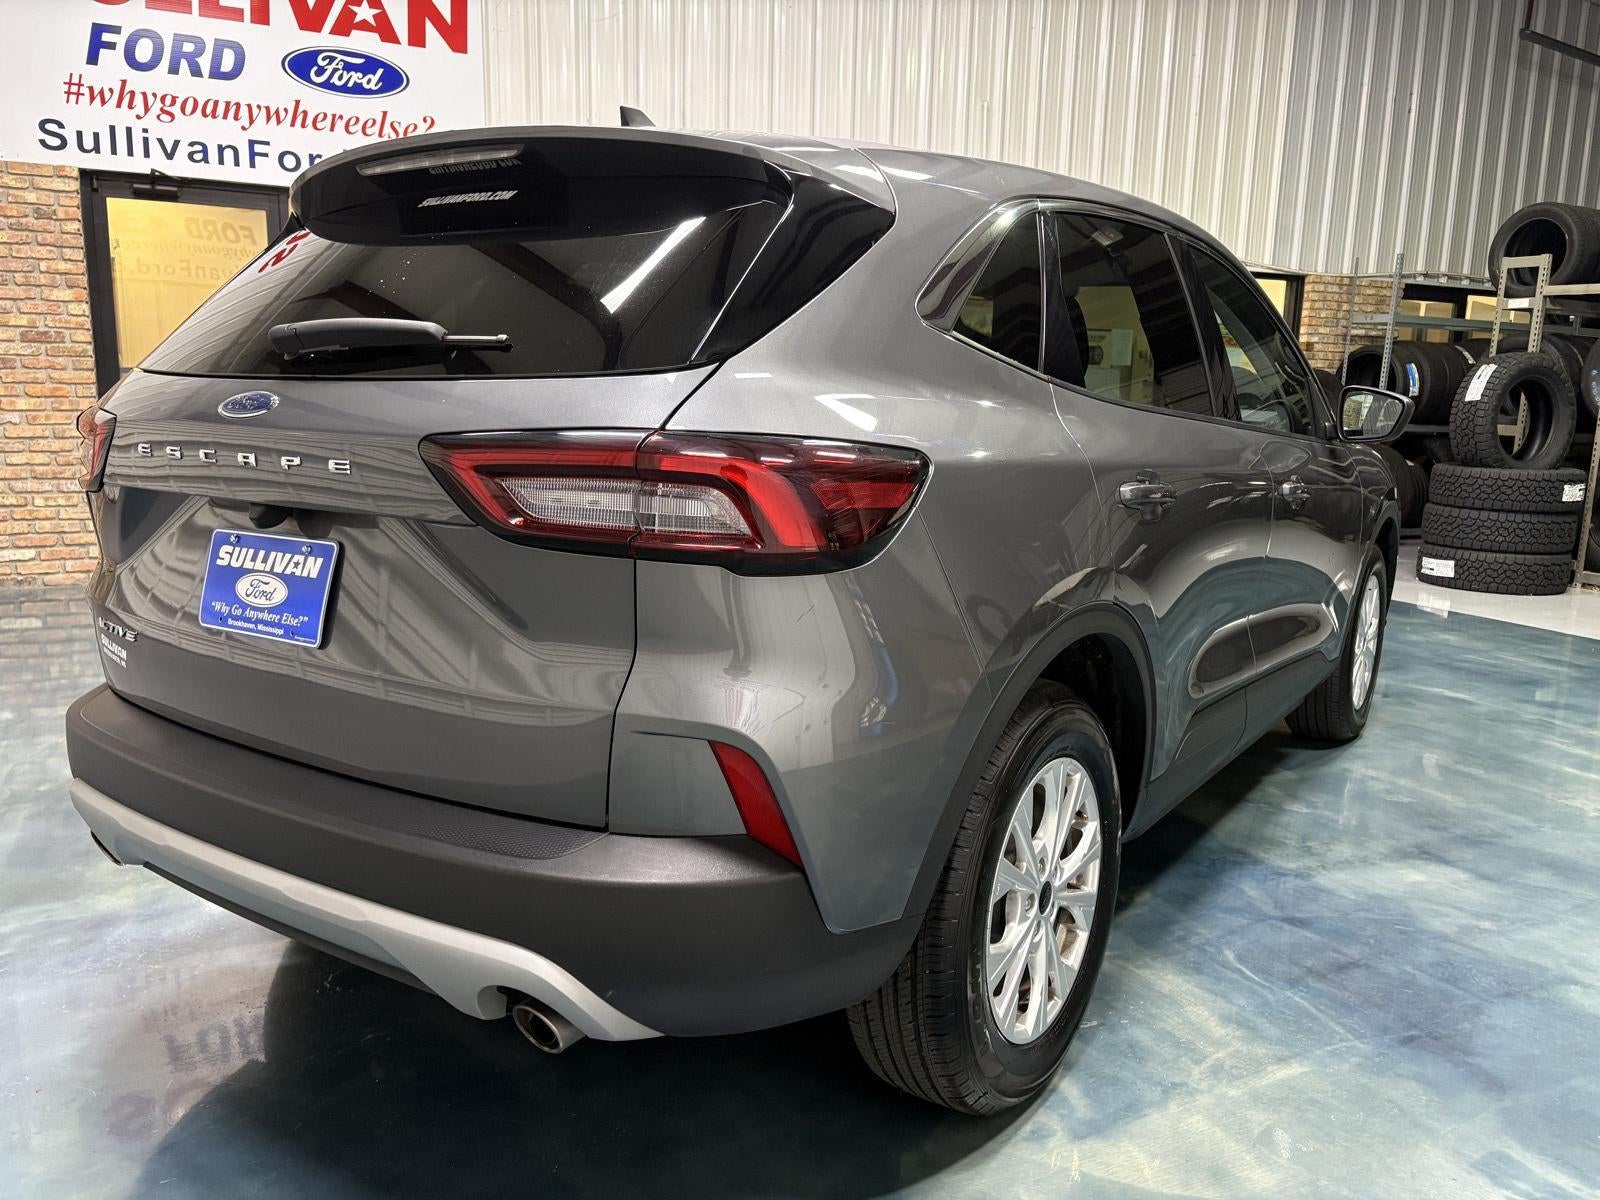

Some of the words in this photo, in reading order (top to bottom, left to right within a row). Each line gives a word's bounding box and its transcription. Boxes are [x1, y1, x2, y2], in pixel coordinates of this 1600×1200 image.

[86, 22, 246, 81] FORD
[310, 52, 384, 90] Ford
[63, 73, 435, 138] #whygoanywhereelse?
[38, 118, 348, 172] SullivanFor
[138, 443, 351, 475] ESCAPE
[216, 545, 324, 578] SULLIVAN
[245, 579, 277, 602] Ford
[231, 604, 242, 615] Go
[243, 607, 281, 622] Anywhere
[257, 624, 284, 636] Mississippi
